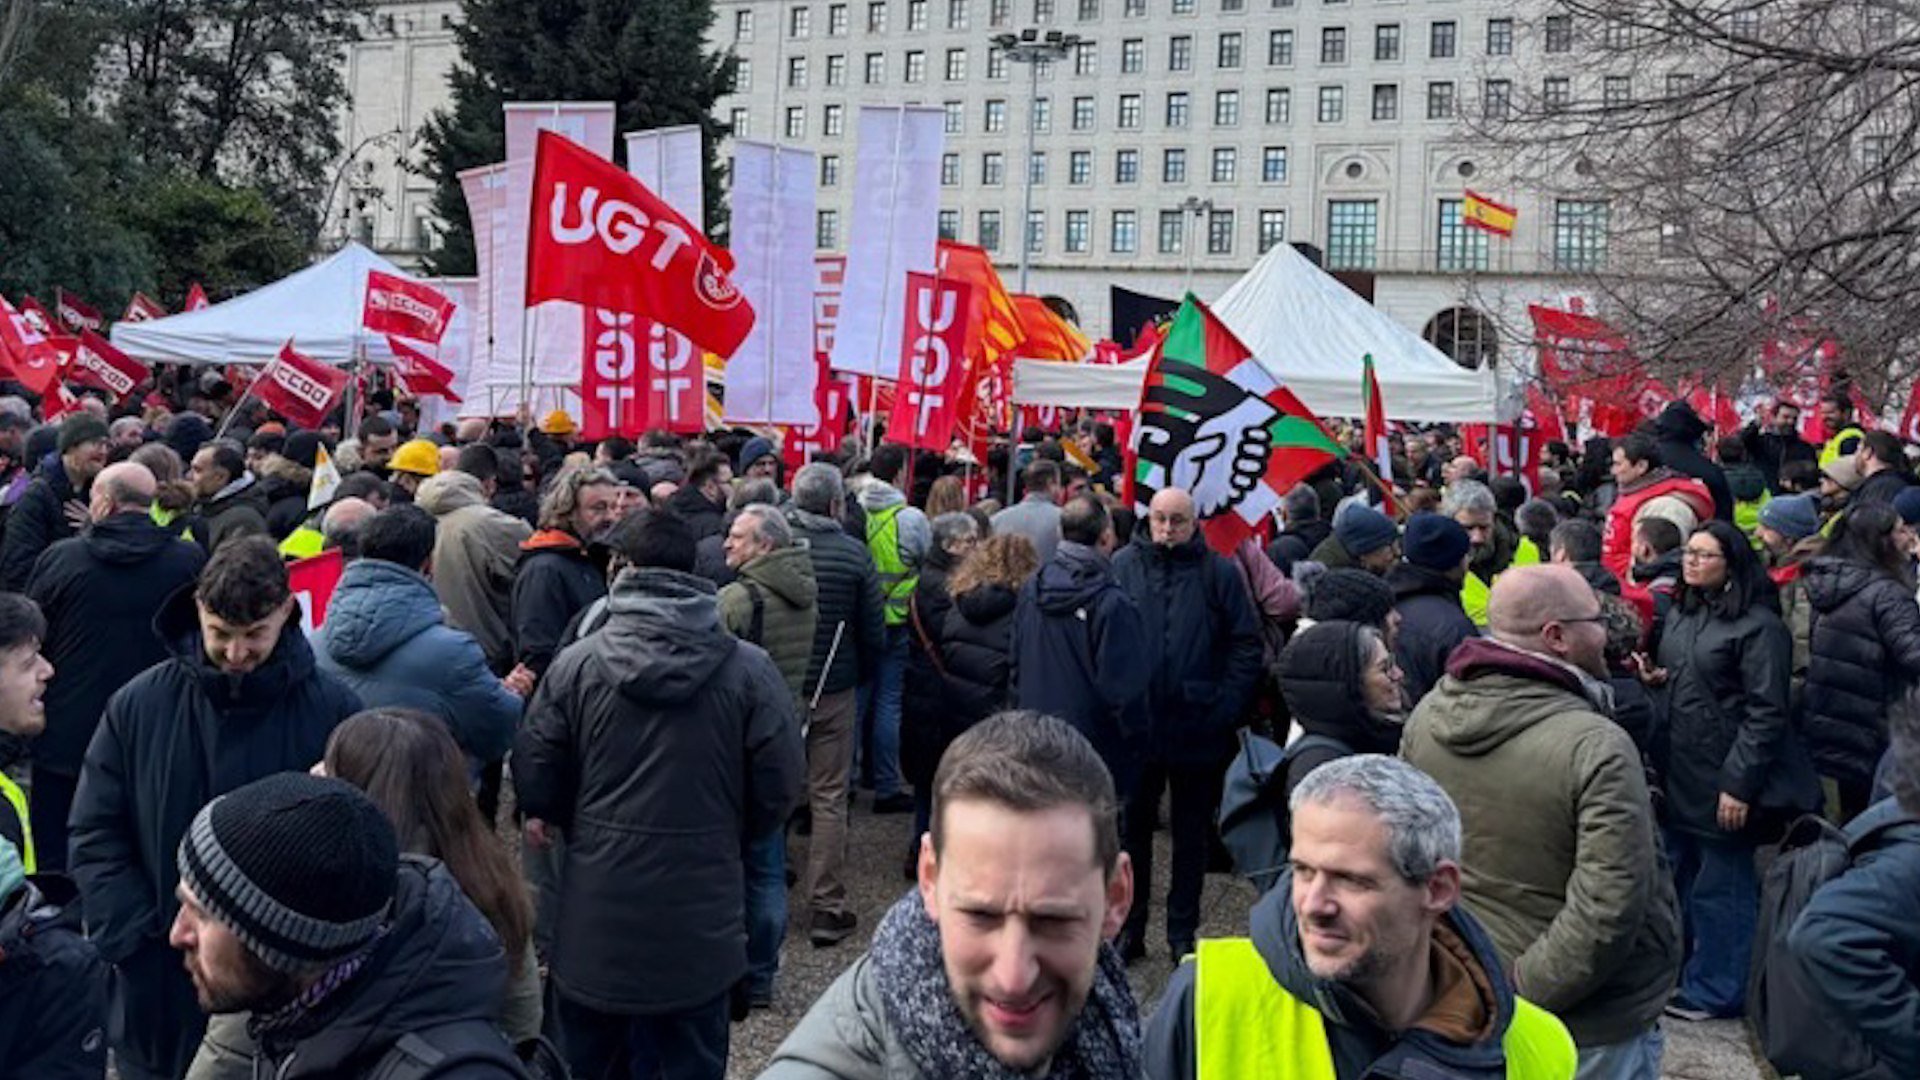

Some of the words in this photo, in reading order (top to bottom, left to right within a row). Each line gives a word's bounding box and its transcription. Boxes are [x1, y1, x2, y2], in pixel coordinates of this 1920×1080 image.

[551, 181, 692, 272] UGT
[89, 356, 130, 389] CCOO
[277, 366, 327, 403] CCOO
